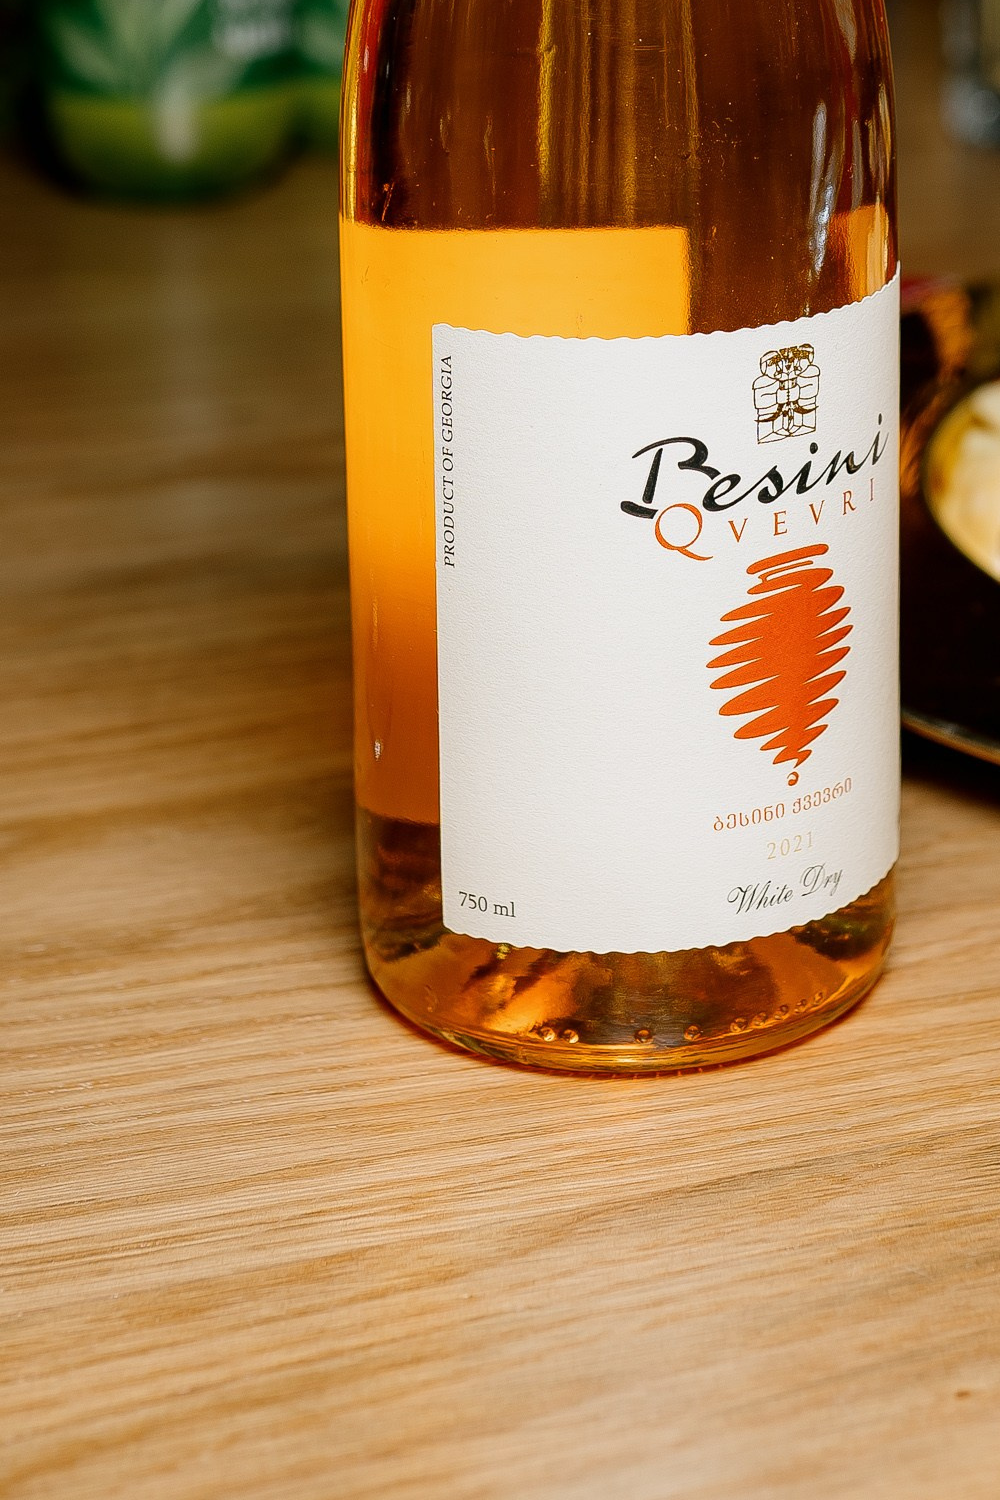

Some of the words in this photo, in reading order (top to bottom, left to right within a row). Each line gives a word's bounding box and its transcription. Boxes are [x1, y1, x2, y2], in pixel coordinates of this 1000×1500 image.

[440, 355, 453, 443] GEORGIA
[441, 446, 455, 473] OF
[619, 412, 890, 520] Besini
[442, 475, 456, 569] PRODUCT
[654, 477, 876, 562] QVEVRI
[713, 802, 786, 832] ბესინი
[792, 777, 853, 815] ქვევრი
[766, 830, 814, 860] 2021
[458, 890, 488, 913] 750
[493, 901, 516, 918] ml
[726, 879, 794, 915] White
[799, 862, 843, 897] Dry
